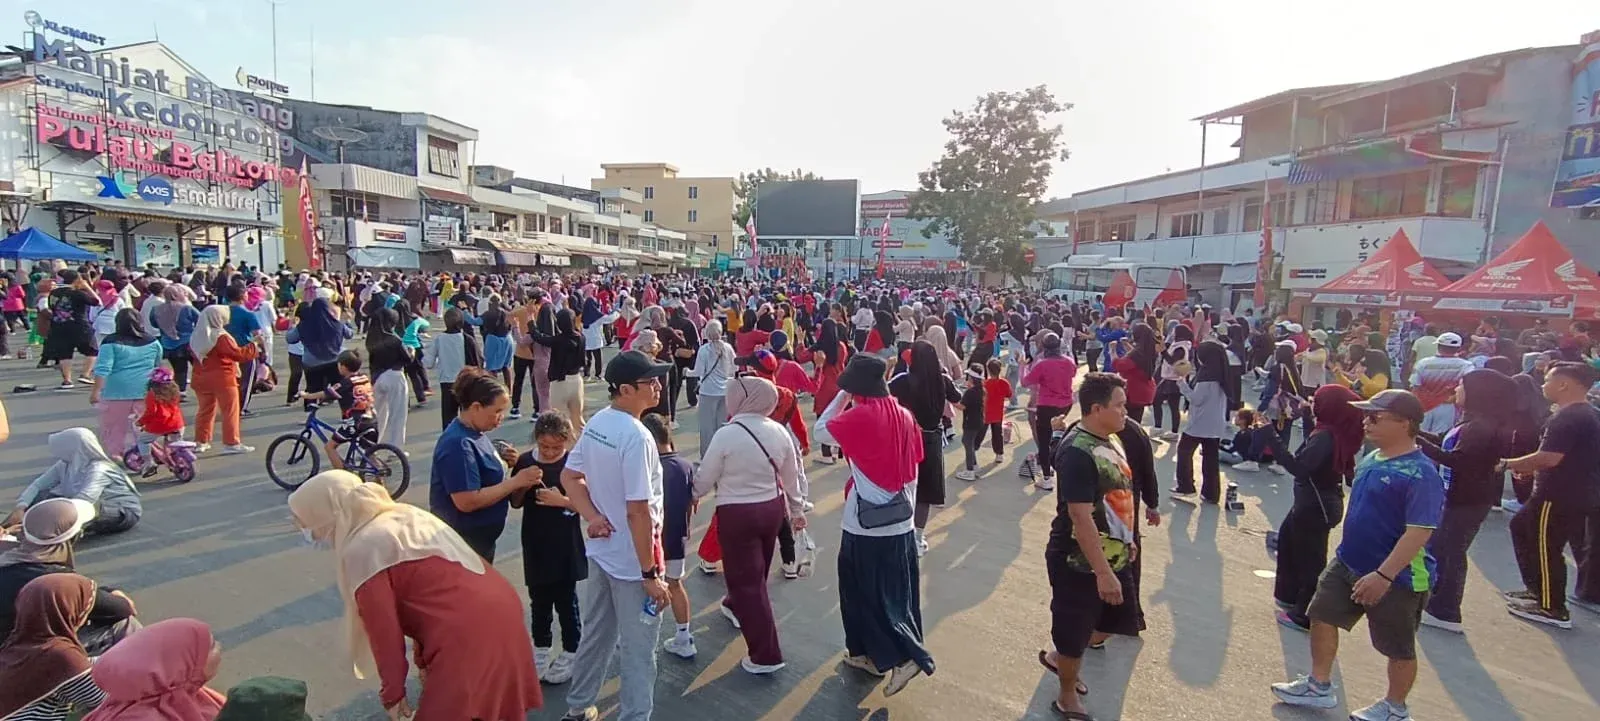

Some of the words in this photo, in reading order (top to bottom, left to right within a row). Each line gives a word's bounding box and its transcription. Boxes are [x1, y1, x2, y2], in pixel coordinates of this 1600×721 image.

[44, 20, 106, 46] XLSMART
[34, 32, 170, 94] Manjat
[185, 76, 293, 130] Batang
[55, 78, 104, 99] Pohon
[37, 103, 104, 126] Selamat
[107, 86, 294, 156] Kedondong
[37, 116, 154, 160] Pulau
[171, 141, 299, 188] Belitong
[111, 155, 160, 174] Nikmati
[160, 163, 207, 181] Internet
[143, 185, 170, 197] AXIS
[179, 186, 259, 211] smartfren
[859, 227, 893, 237] BABL
